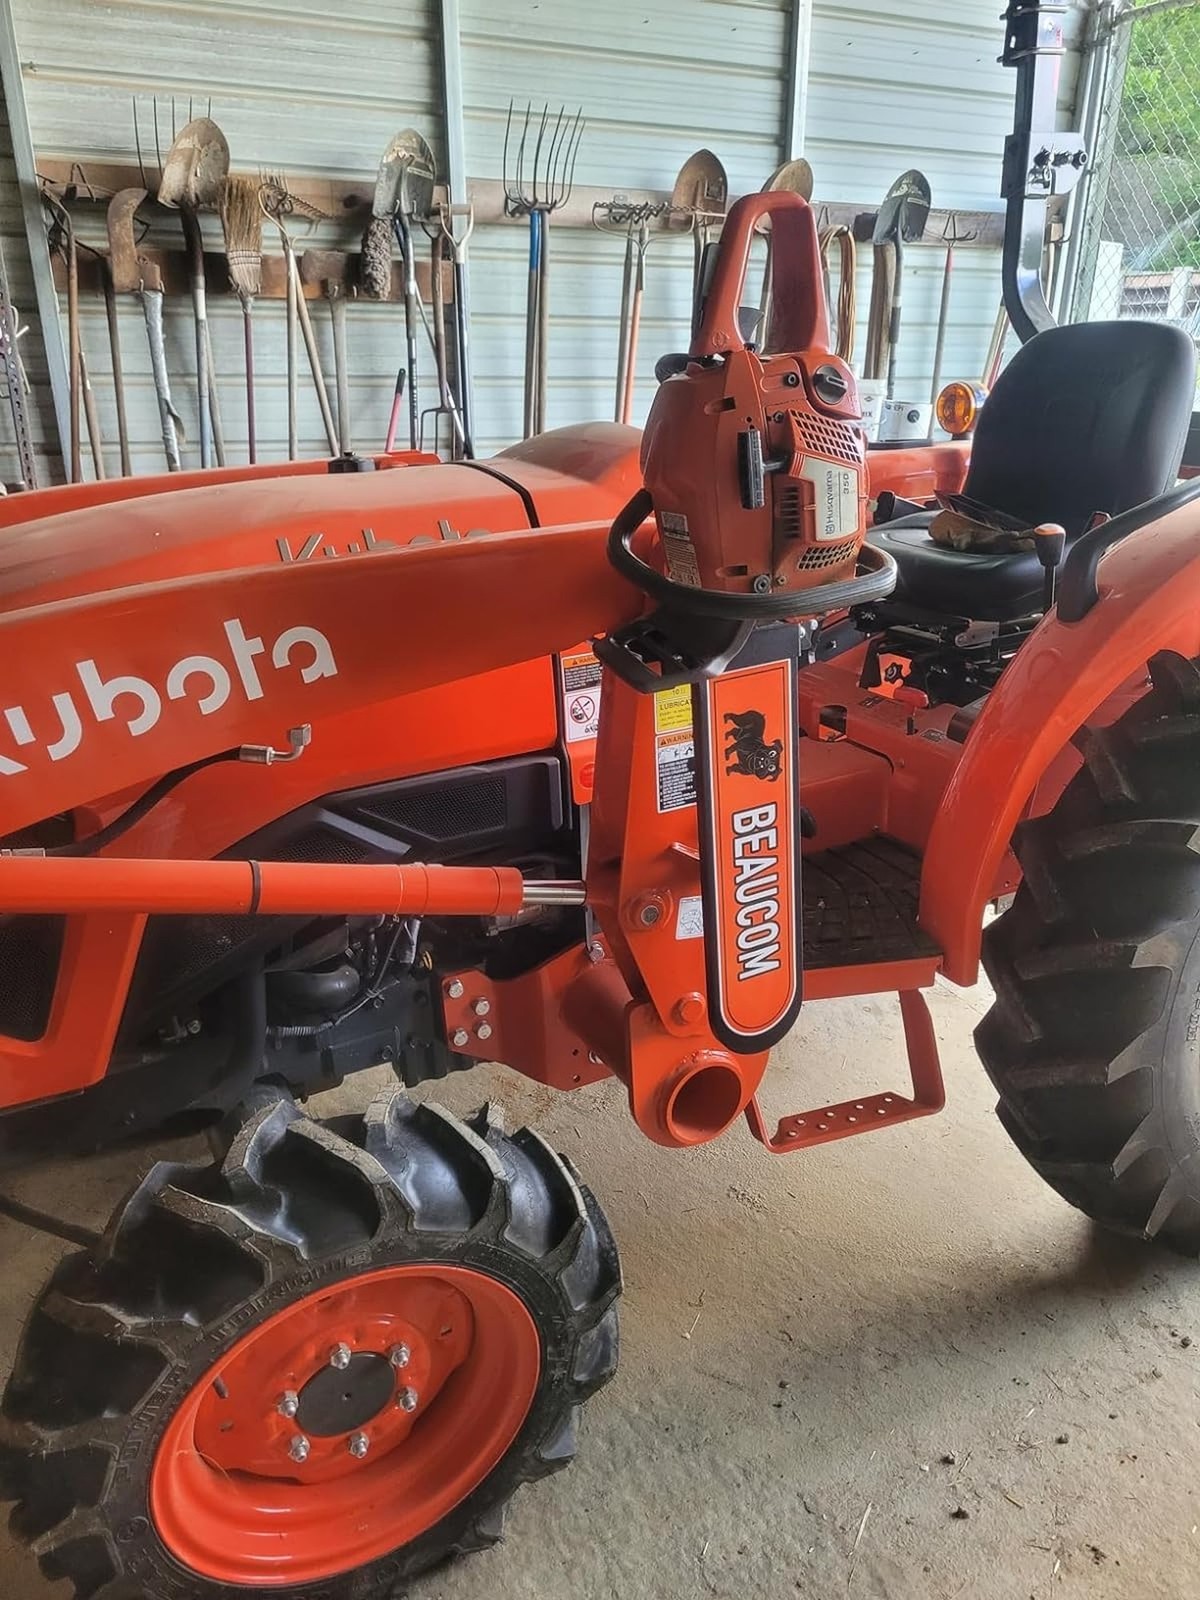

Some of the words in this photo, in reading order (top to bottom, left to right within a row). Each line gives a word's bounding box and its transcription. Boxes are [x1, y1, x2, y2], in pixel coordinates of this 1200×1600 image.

[842, 473, 850, 495] 350
[826, 470, 834, 525] Husqvarna
[659, 699, 692, 711] LUBRICA
[666, 732, 694, 744] WARNIN
[731, 801, 781, 981] BEAUCOM
